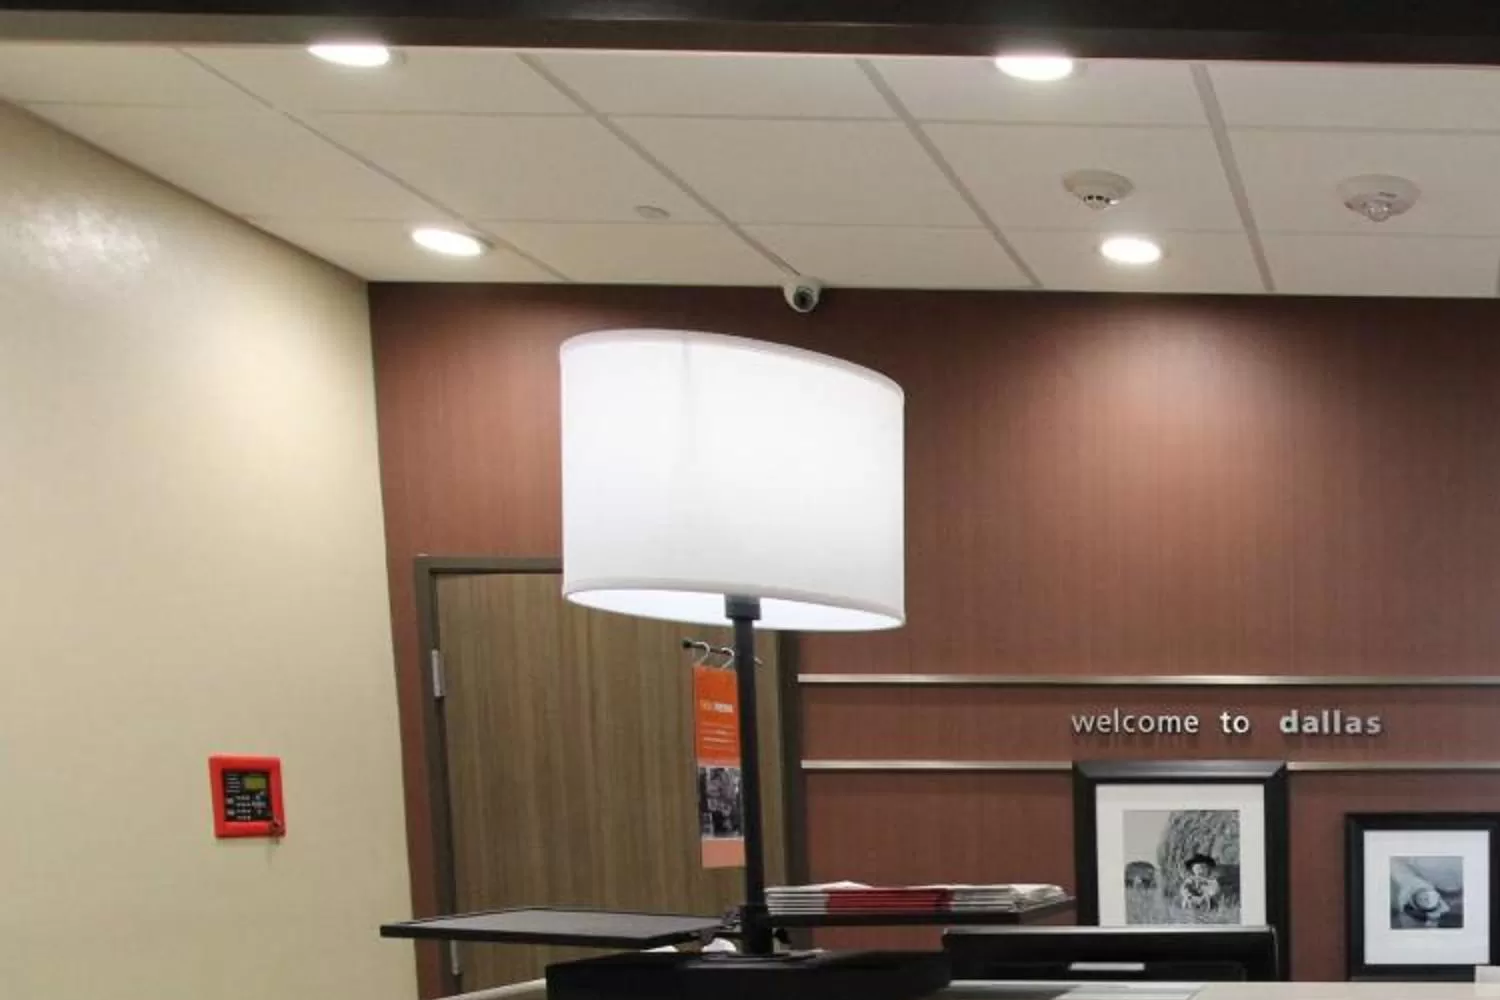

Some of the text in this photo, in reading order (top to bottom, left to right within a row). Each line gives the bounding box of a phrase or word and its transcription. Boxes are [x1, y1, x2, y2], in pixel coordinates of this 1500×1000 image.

[1071, 707, 1381, 734] welcome to dallas
